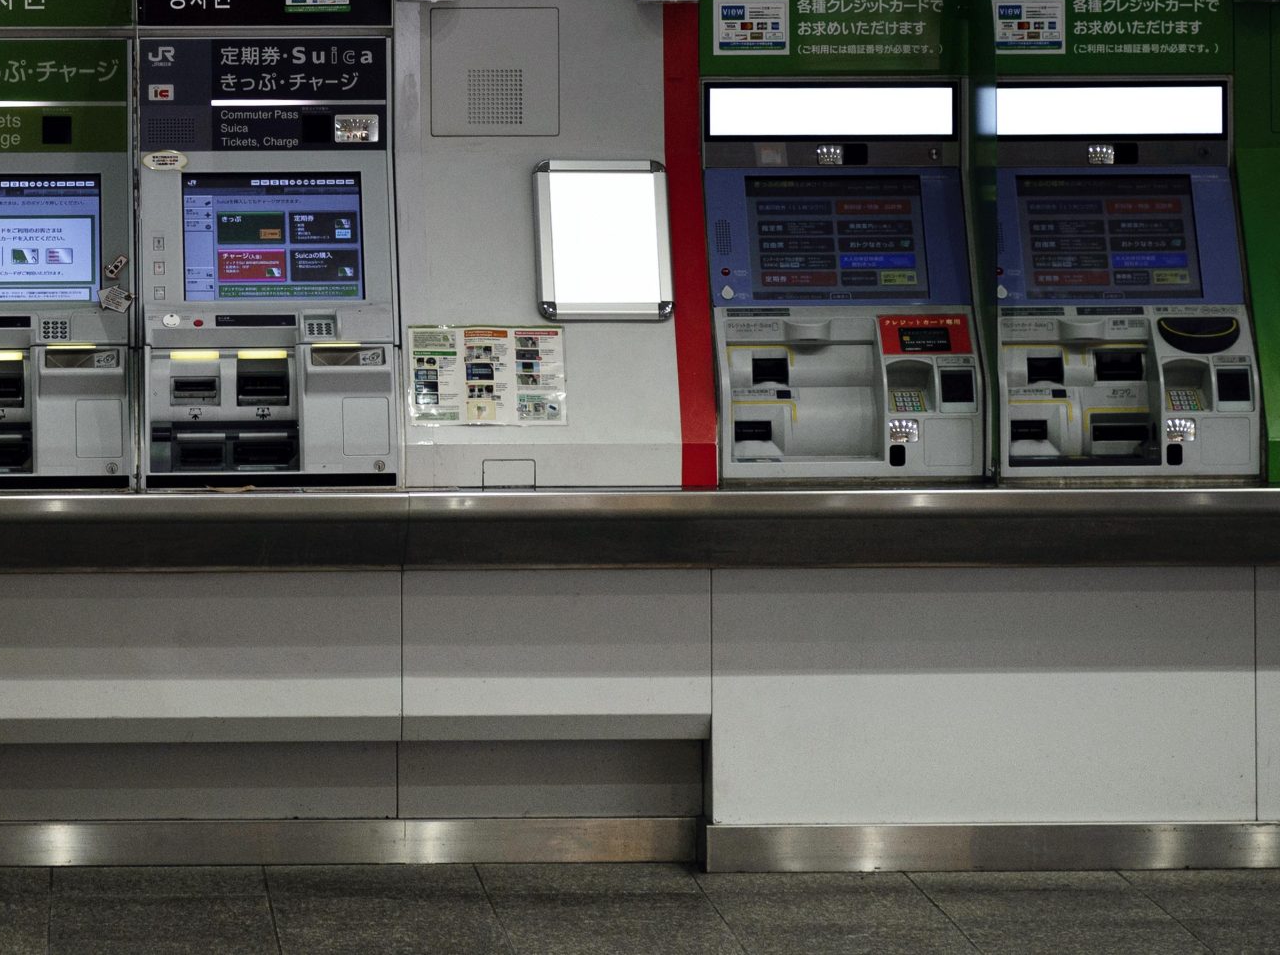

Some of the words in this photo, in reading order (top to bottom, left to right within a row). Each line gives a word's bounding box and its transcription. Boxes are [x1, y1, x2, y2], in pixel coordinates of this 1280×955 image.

[797, 0, 944, 14] 各種クレジットカードで
[797, 21, 927, 36] お求めいただけます
[1073, 20, 1203, 35] お求めいただけます
[148, 46, 175, 62] JR
[220, 72, 359, 91] きっぷ・チャージ
[220, 110, 272, 120] Commuter
[274, 110, 299, 120] Pass
[220, 124, 249, 133] Suica
[221, 137, 260, 148] Tickets,
[262, 137, 299, 148] Charge
